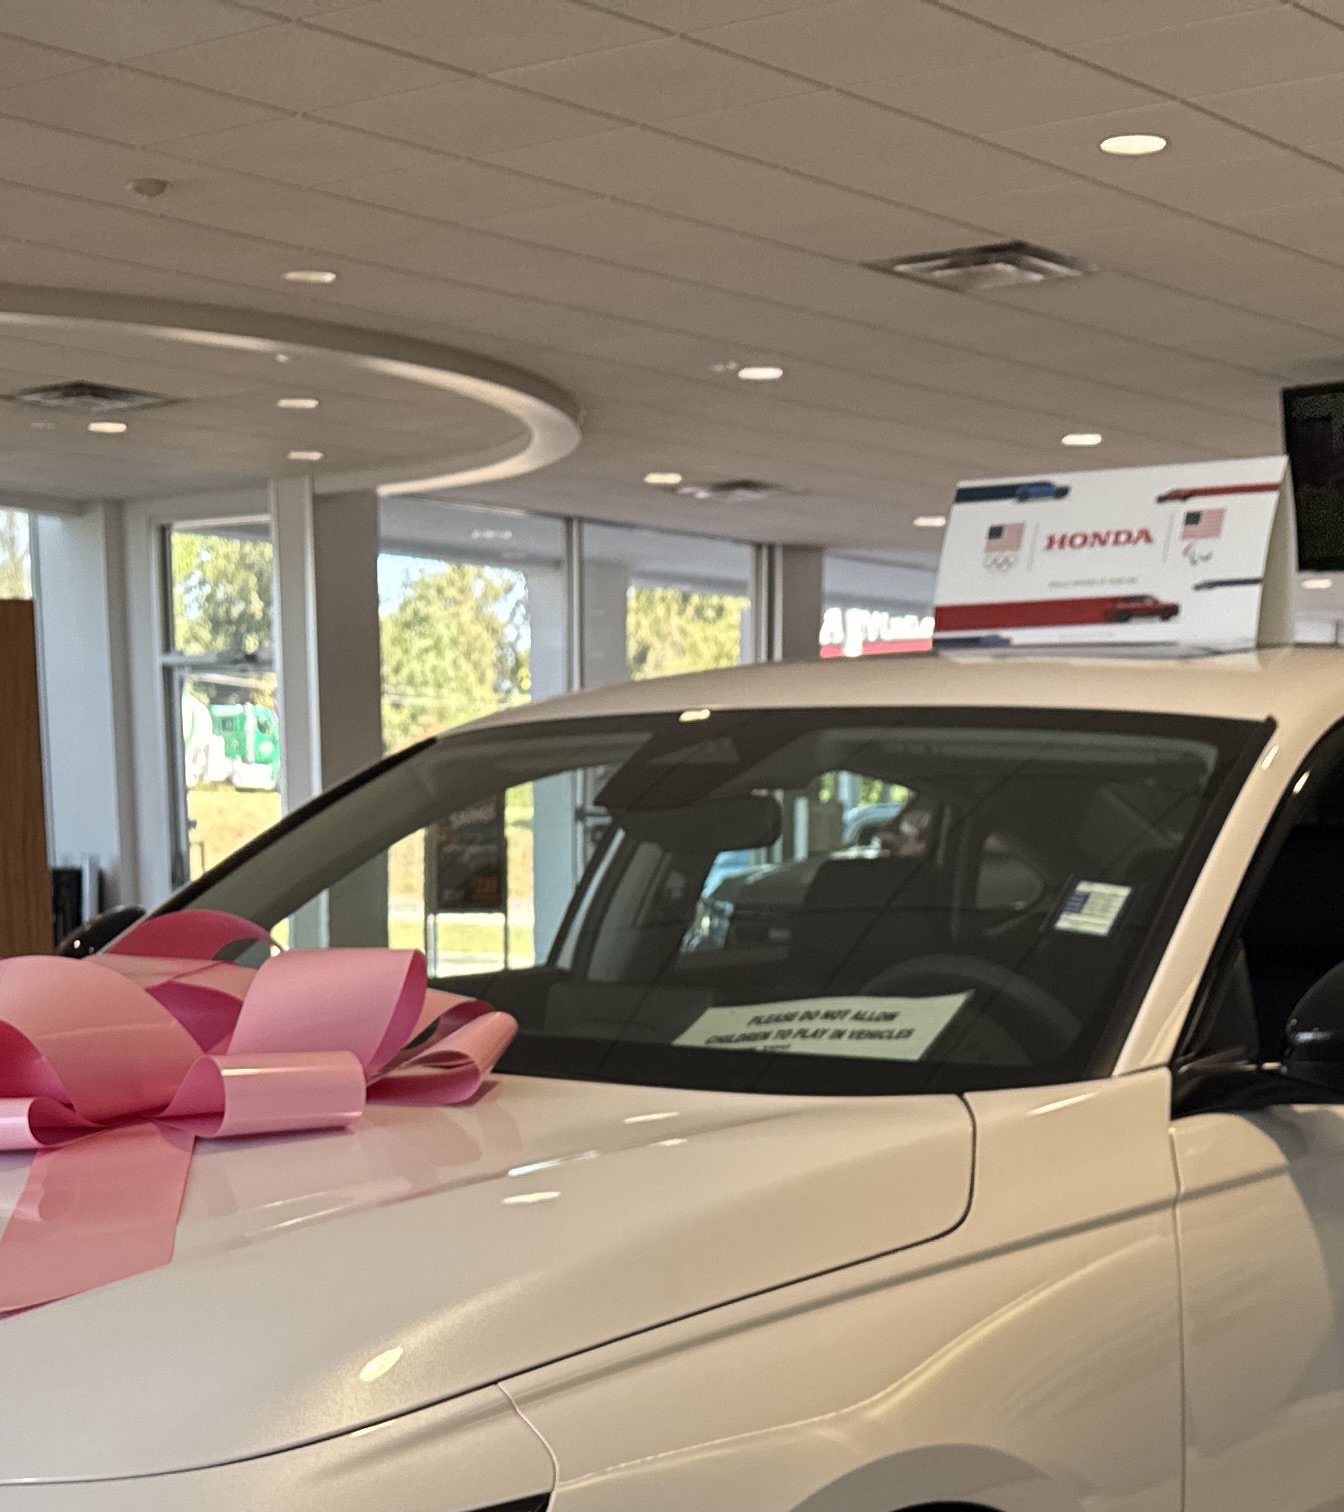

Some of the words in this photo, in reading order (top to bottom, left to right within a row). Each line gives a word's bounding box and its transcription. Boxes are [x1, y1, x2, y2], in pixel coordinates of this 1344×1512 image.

[1044, 527, 1153, 551] HONDA
[747, 1012, 798, 1026] PLEASE
[799, 1010, 819, 1022] DO
[821, 1010, 850, 1021] NOT
[851, 1011, 900, 1022] ALLOW
[705, 1031, 772, 1044] CHILDREN
[775, 1029, 793, 1040] TO
[794, 1028, 828, 1040] PLAY
[829, 1029, 845, 1040] IN
[847, 1028, 915, 1040] VEHICLES
